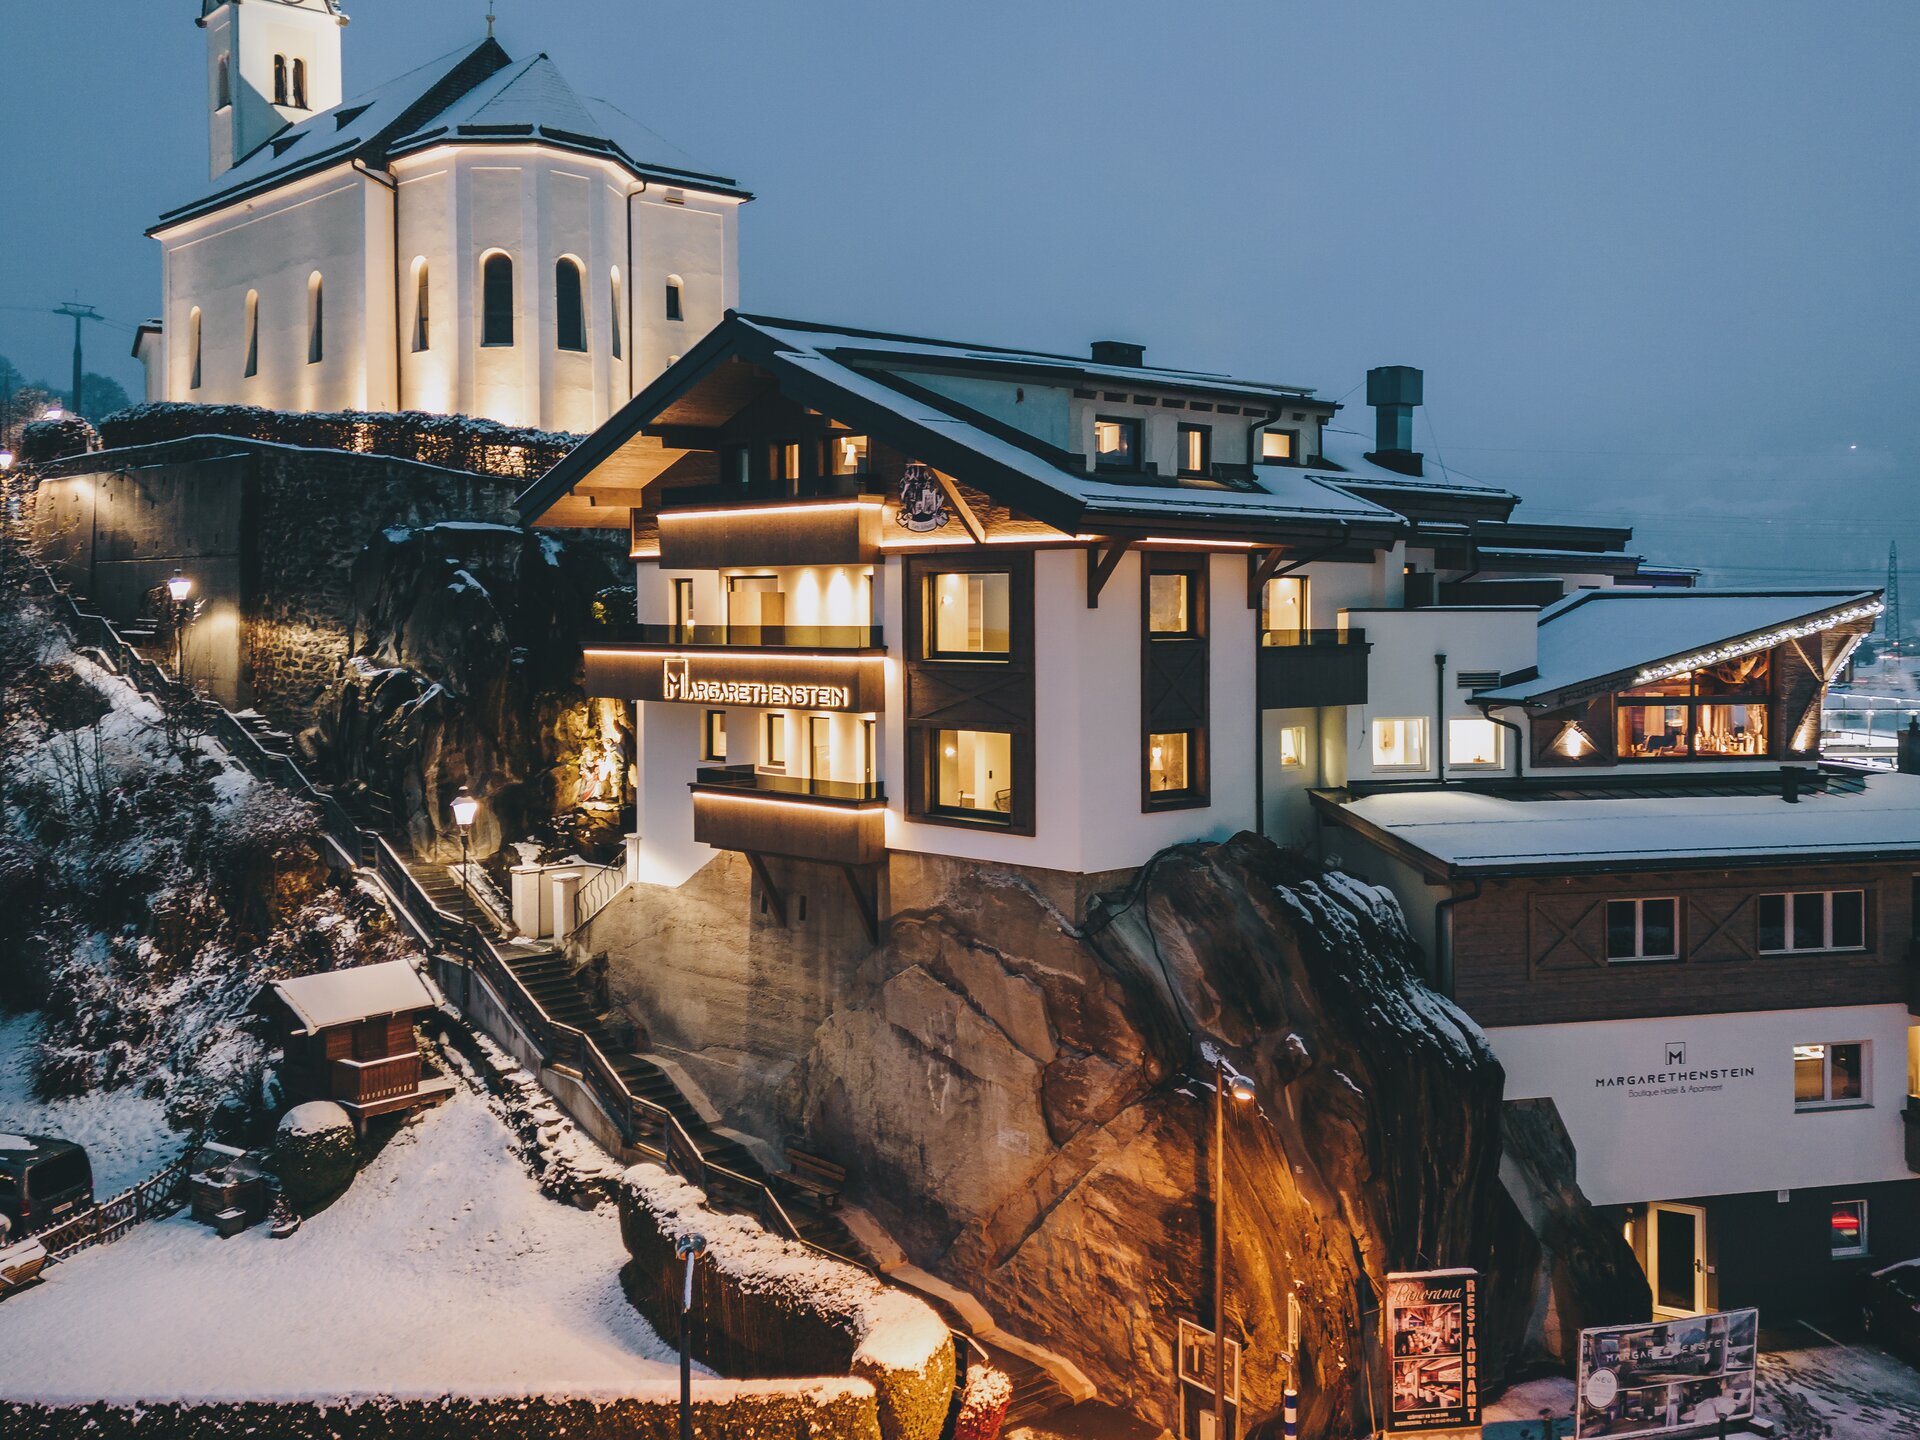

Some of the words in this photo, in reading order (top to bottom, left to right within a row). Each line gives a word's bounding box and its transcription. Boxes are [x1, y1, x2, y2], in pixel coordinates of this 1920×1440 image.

[663, 662, 848, 707] MARGARETHENSTEIN
[1667, 1049, 1685, 1065] M
[1595, 1067, 1754, 1087] MARGARETHENSTEIN
[1628, 1089, 1659, 1098] Boutique
[1661, 1086, 1678, 1095] Hotel
[1680, 1085, 1686, 1093] &
[1396, 1284, 1461, 1303] Panorama
[1466, 1280, 1477, 1421] RESTAURANT
[1594, 1376, 1613, 1384] NEU
